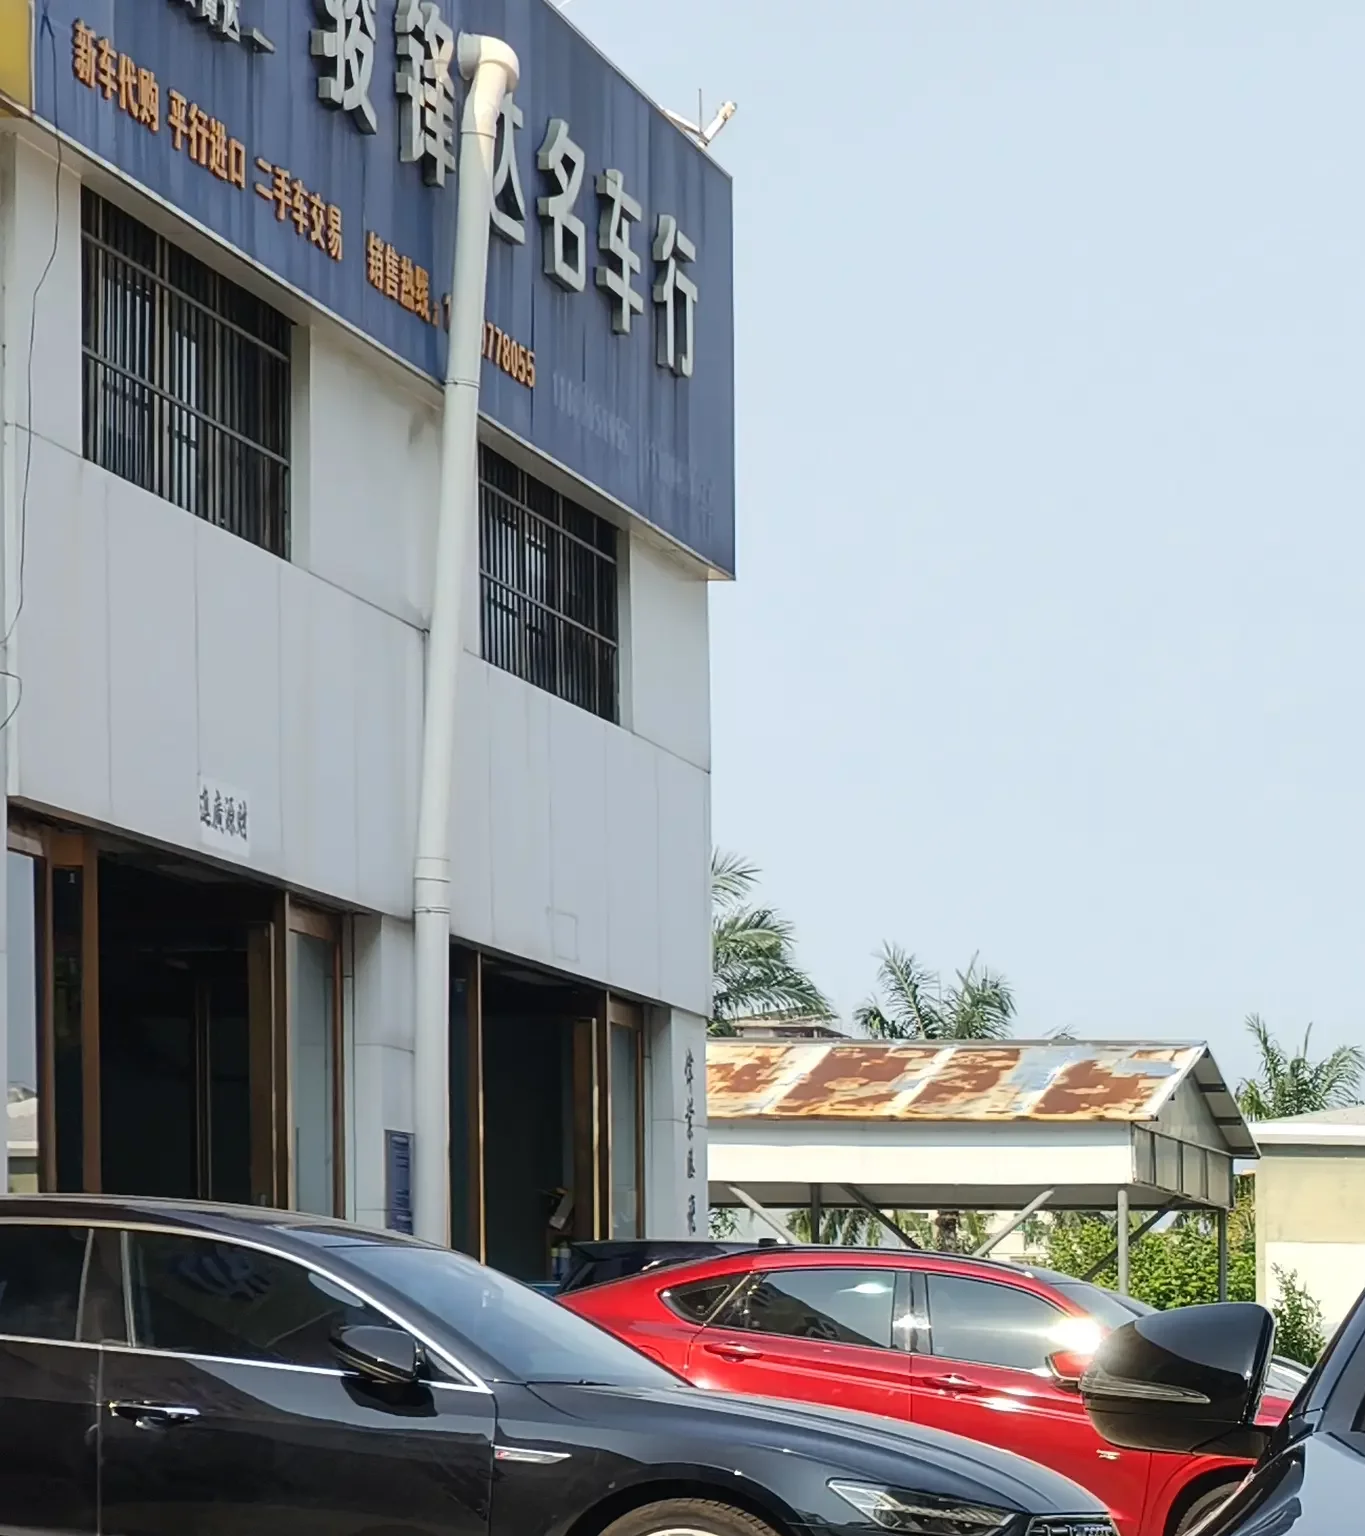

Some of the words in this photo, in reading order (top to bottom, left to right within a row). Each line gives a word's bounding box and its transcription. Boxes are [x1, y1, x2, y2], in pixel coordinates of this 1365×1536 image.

[71, 18, 159, 133] 新车代购
[168, 88, 246, 189] 平行进口
[255, 157, 343, 262] 二手车交易
